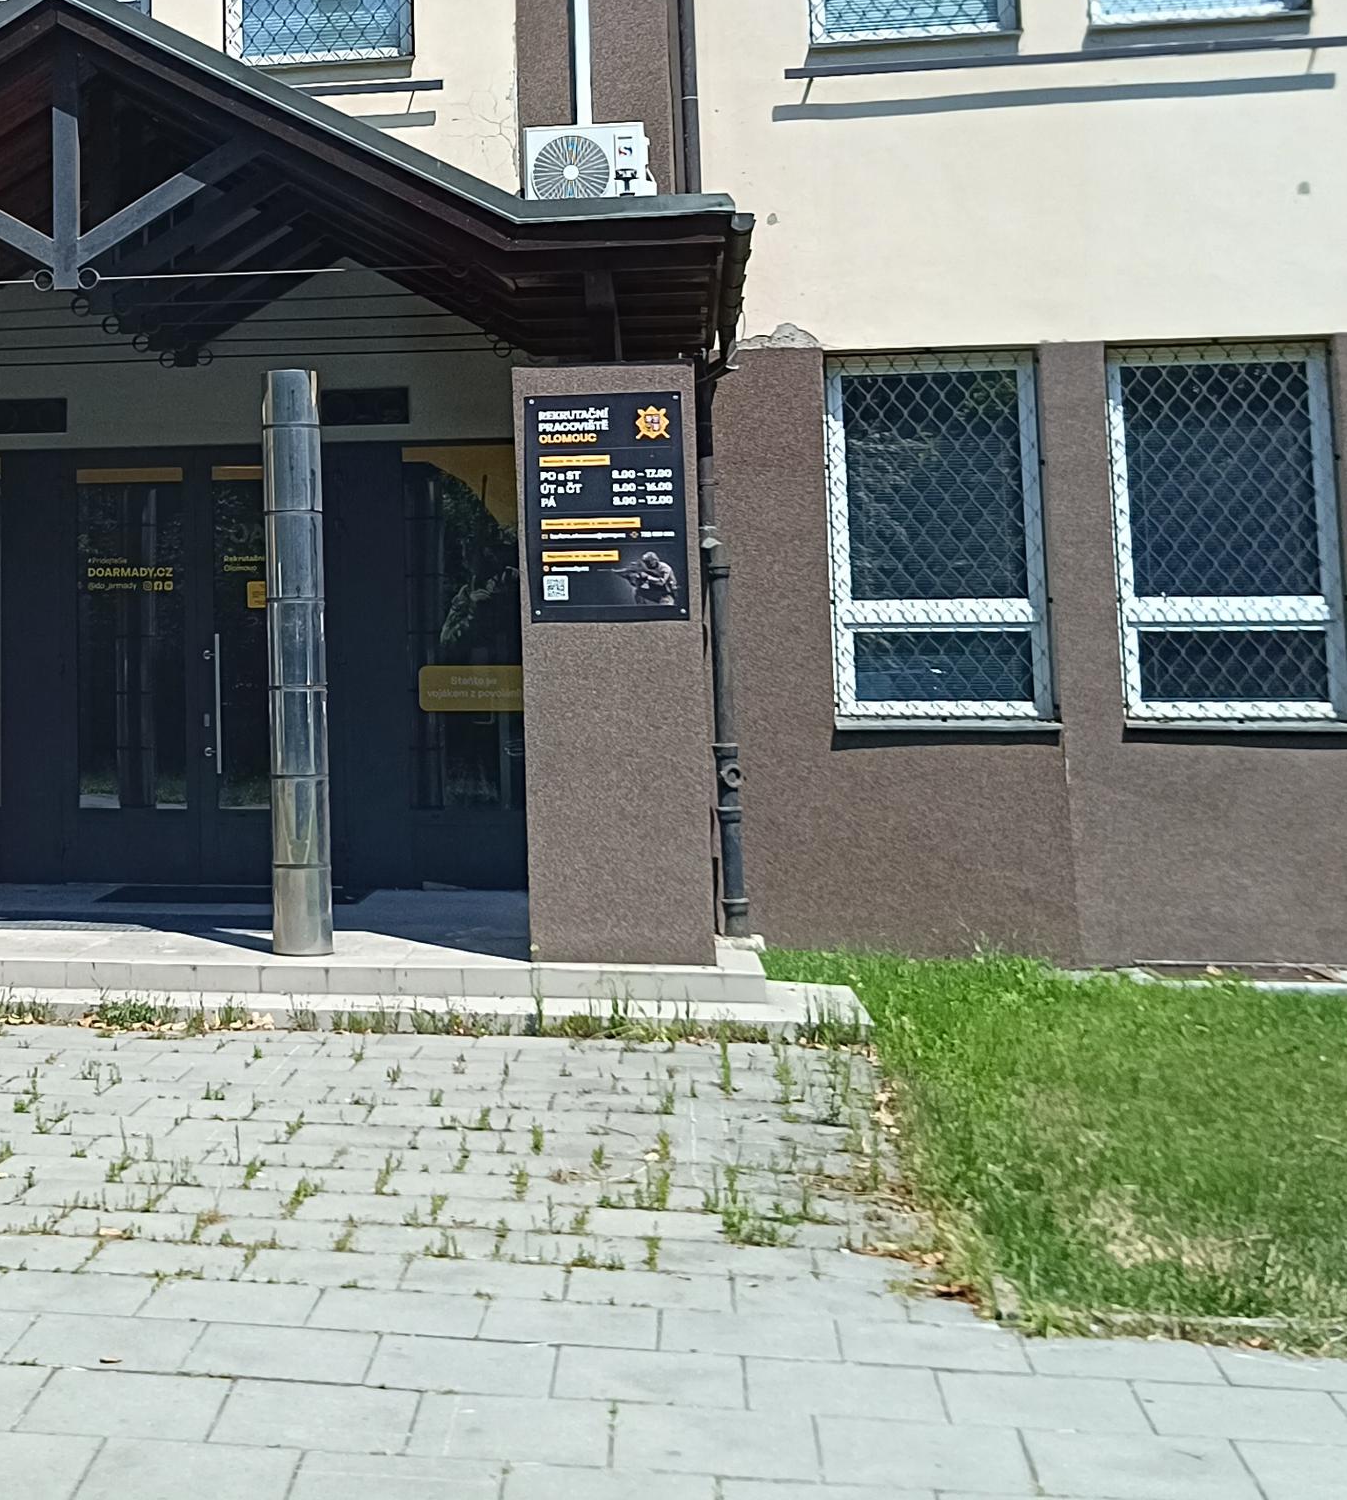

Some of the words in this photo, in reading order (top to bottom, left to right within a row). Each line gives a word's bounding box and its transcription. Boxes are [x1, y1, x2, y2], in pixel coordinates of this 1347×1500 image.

[538, 407, 609, 420] REKRUTAČNÍ
[538, 419, 609, 432] PRACOVIŠTĚ
[538, 433, 597, 444] OLOMOUC
[540, 471, 557, 481] PO
[565, 470, 582, 480] ST
[540, 482, 557, 494] ÚT
[565, 481, 583, 494] ČT
[540, 495, 557, 508] PÁ
[87, 567, 174, 578] DOARMADY.CZ
